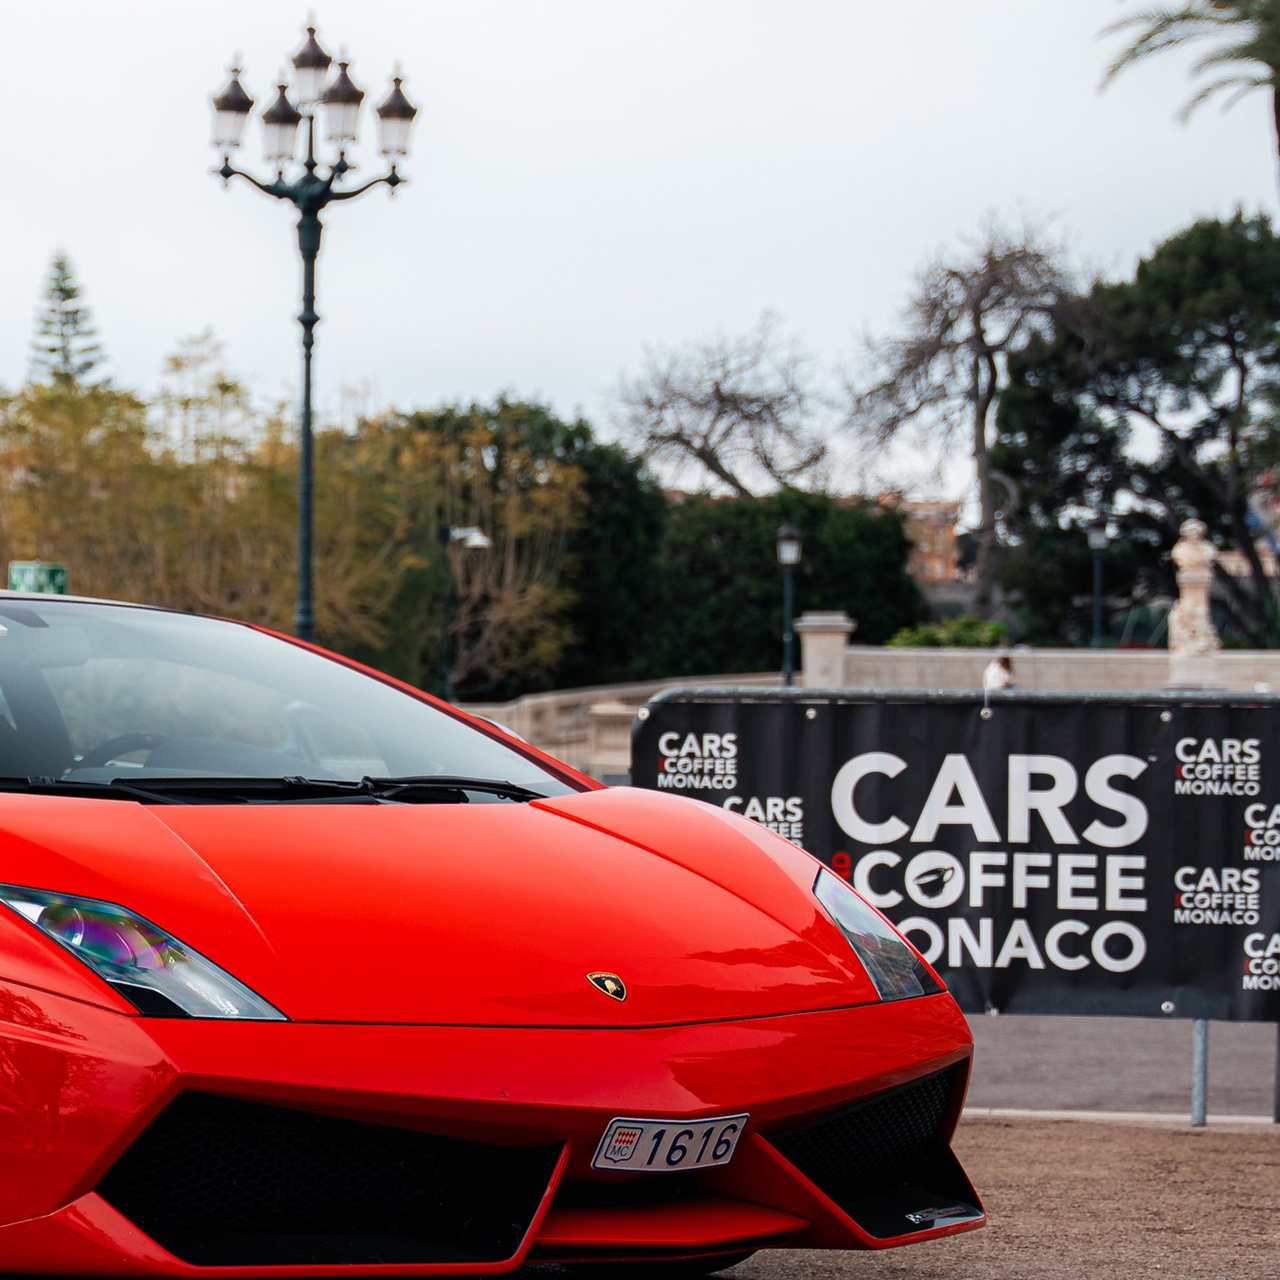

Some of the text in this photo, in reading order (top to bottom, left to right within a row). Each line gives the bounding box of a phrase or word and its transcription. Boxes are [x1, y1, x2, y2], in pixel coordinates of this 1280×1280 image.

[658, 731, 738, 758] CARS
[1175, 737, 1261, 764] CARS
[663, 757, 738, 774] COFFEE
[1181, 763, 1261, 780] COFFEE
[657, 773, 738, 789] MONACO
[1174, 780, 1261, 796] MONACO
[831, 751, 1150, 848] CARS
[853, 849, 1148, 912] COFFEE
[1174, 866, 1261, 893] CARS
[1180, 892, 1261, 910] COFFEE
[1173, 909, 1260, 925] MONACO
[895, 916, 1147, 973] ONACO
[609, 1123, 738, 1166] MC 1616
